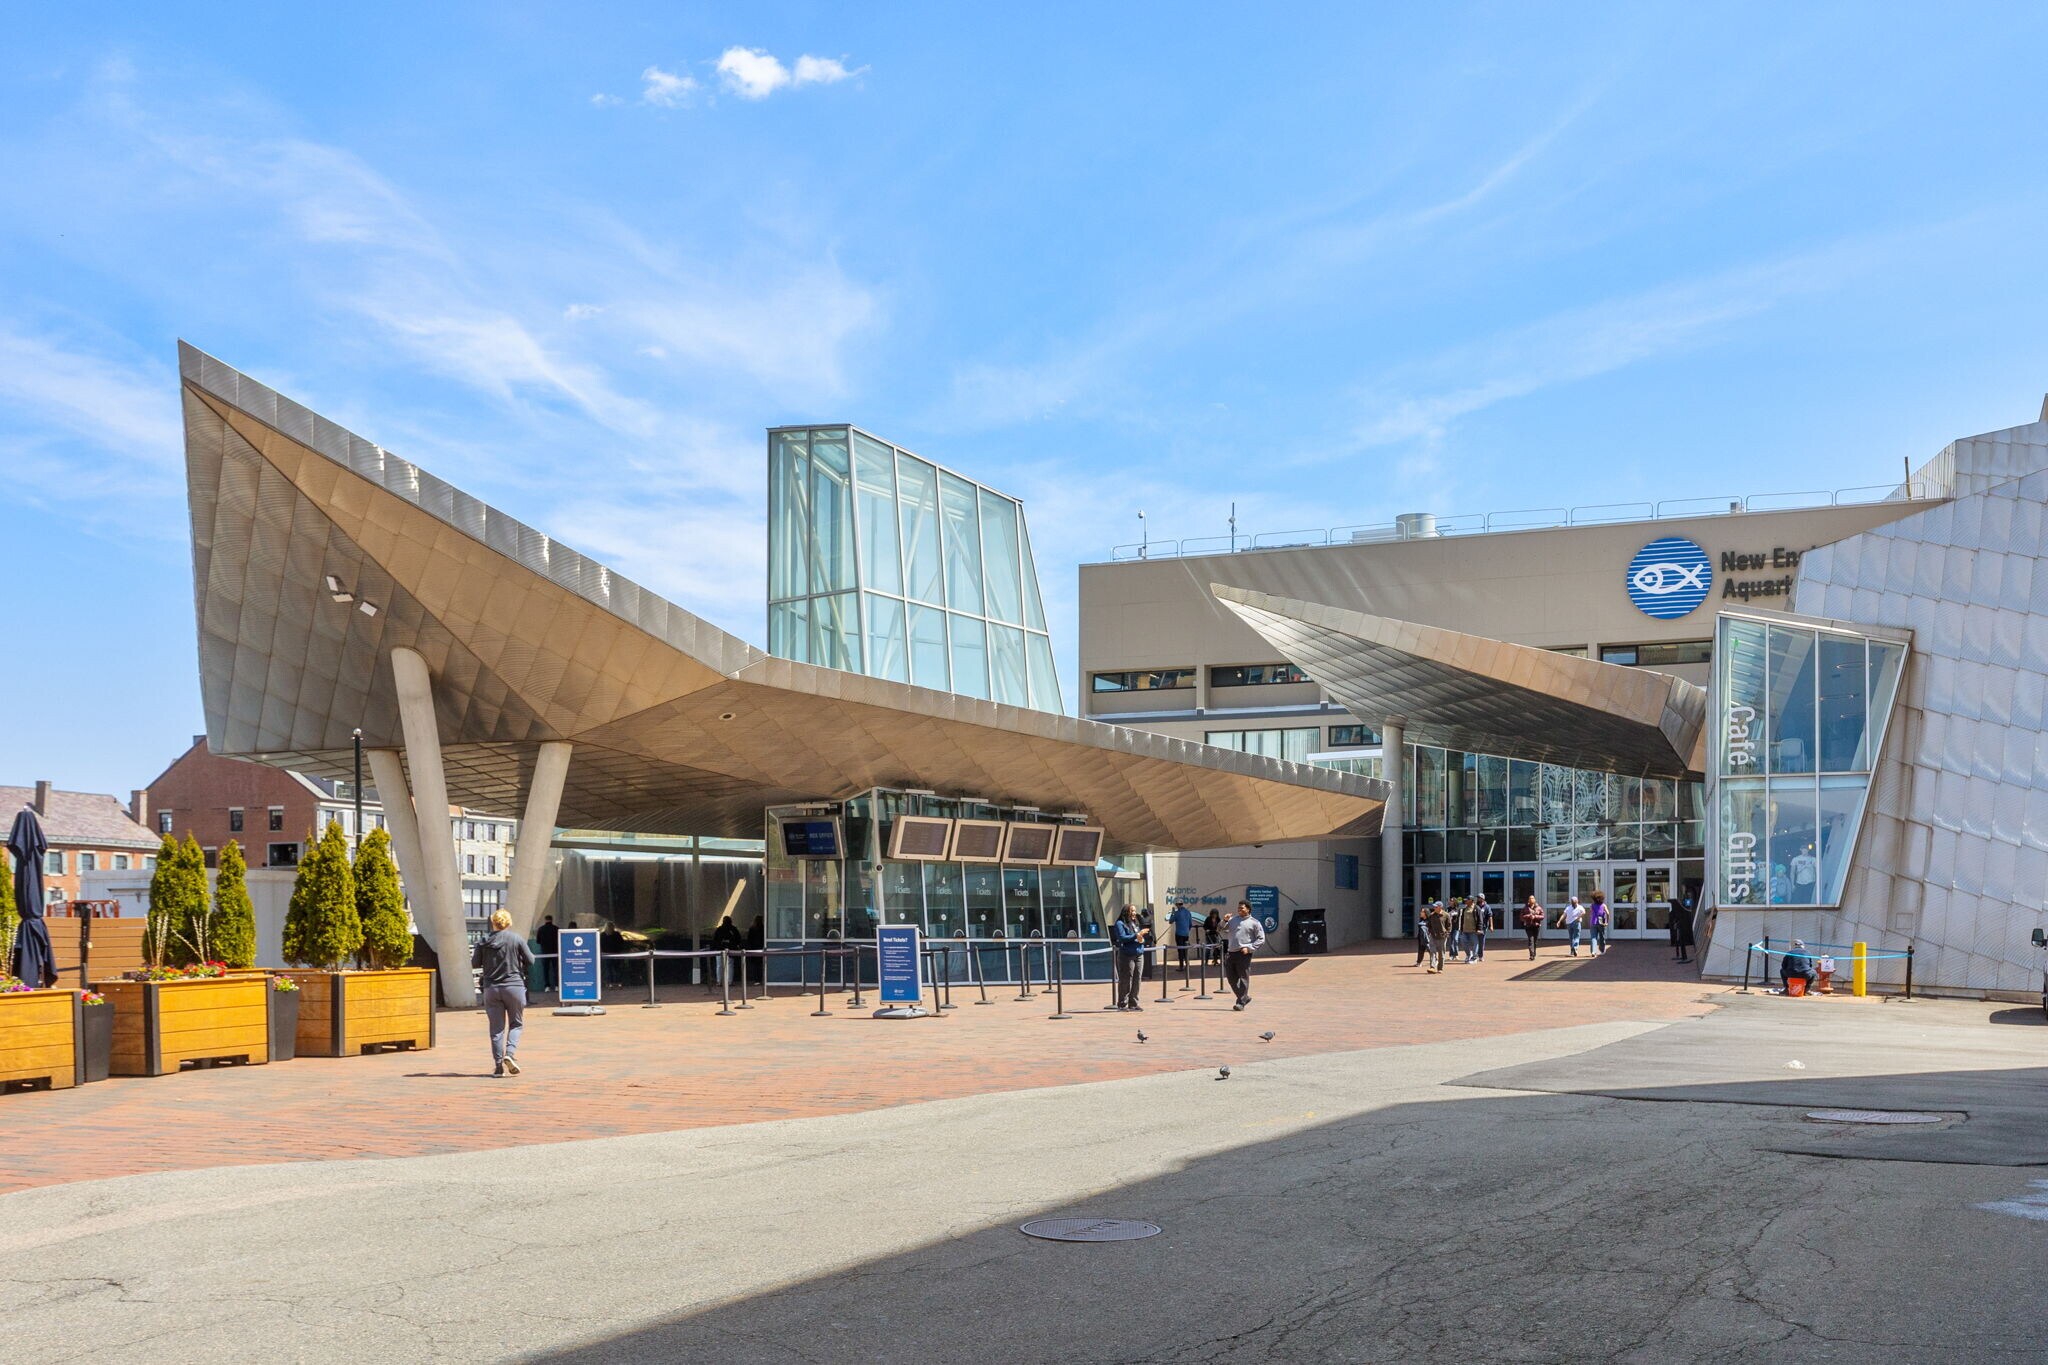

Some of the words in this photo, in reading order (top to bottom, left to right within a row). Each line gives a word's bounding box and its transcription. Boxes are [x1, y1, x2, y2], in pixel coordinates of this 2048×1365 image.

[1721, 551, 1766, 572] New
[1773, 547, 1804, 568] En
[1728, 706, 1756, 766] Café
[1728, 832, 1757, 898] Gifts
[822, 875, 827, 883] 6
[900, 875, 905, 884] 5
[941, 876, 945, 884] 4
[981, 877, 986, 885] 3
[1020, 878, 1024, 887] 2
[1167, 887, 1197, 895] Atlantic
[1166, 896, 1199, 904] Habor
[1201, 896, 1227, 905] Seals
